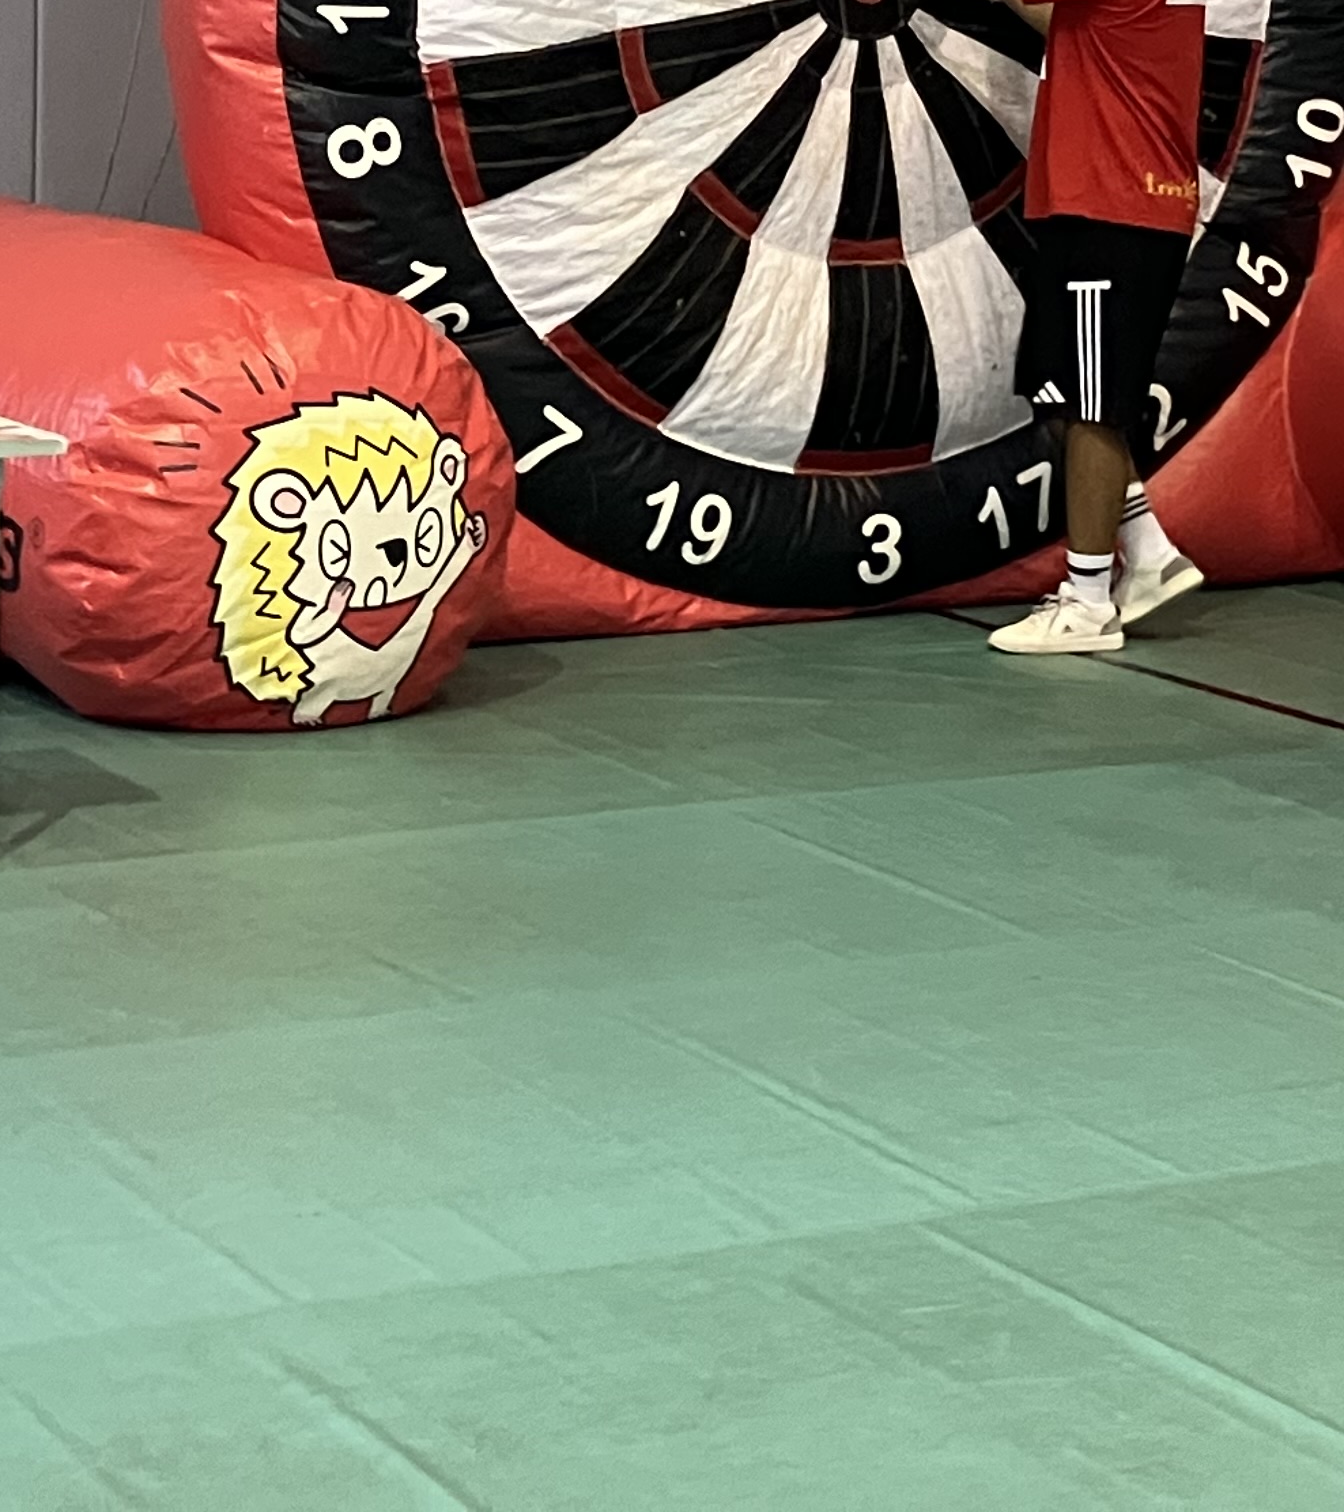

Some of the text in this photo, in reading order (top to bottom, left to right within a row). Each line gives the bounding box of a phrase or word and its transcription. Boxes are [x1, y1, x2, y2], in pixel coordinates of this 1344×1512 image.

[327, 117, 402, 179] 8
[1222, 241, 1289, 327] 15
[516, 404, 583, 474] 7
[645, 480, 732, 565] 19
[977, 461, 1052, 549] 17
[857, 513, 902, 584] 3
